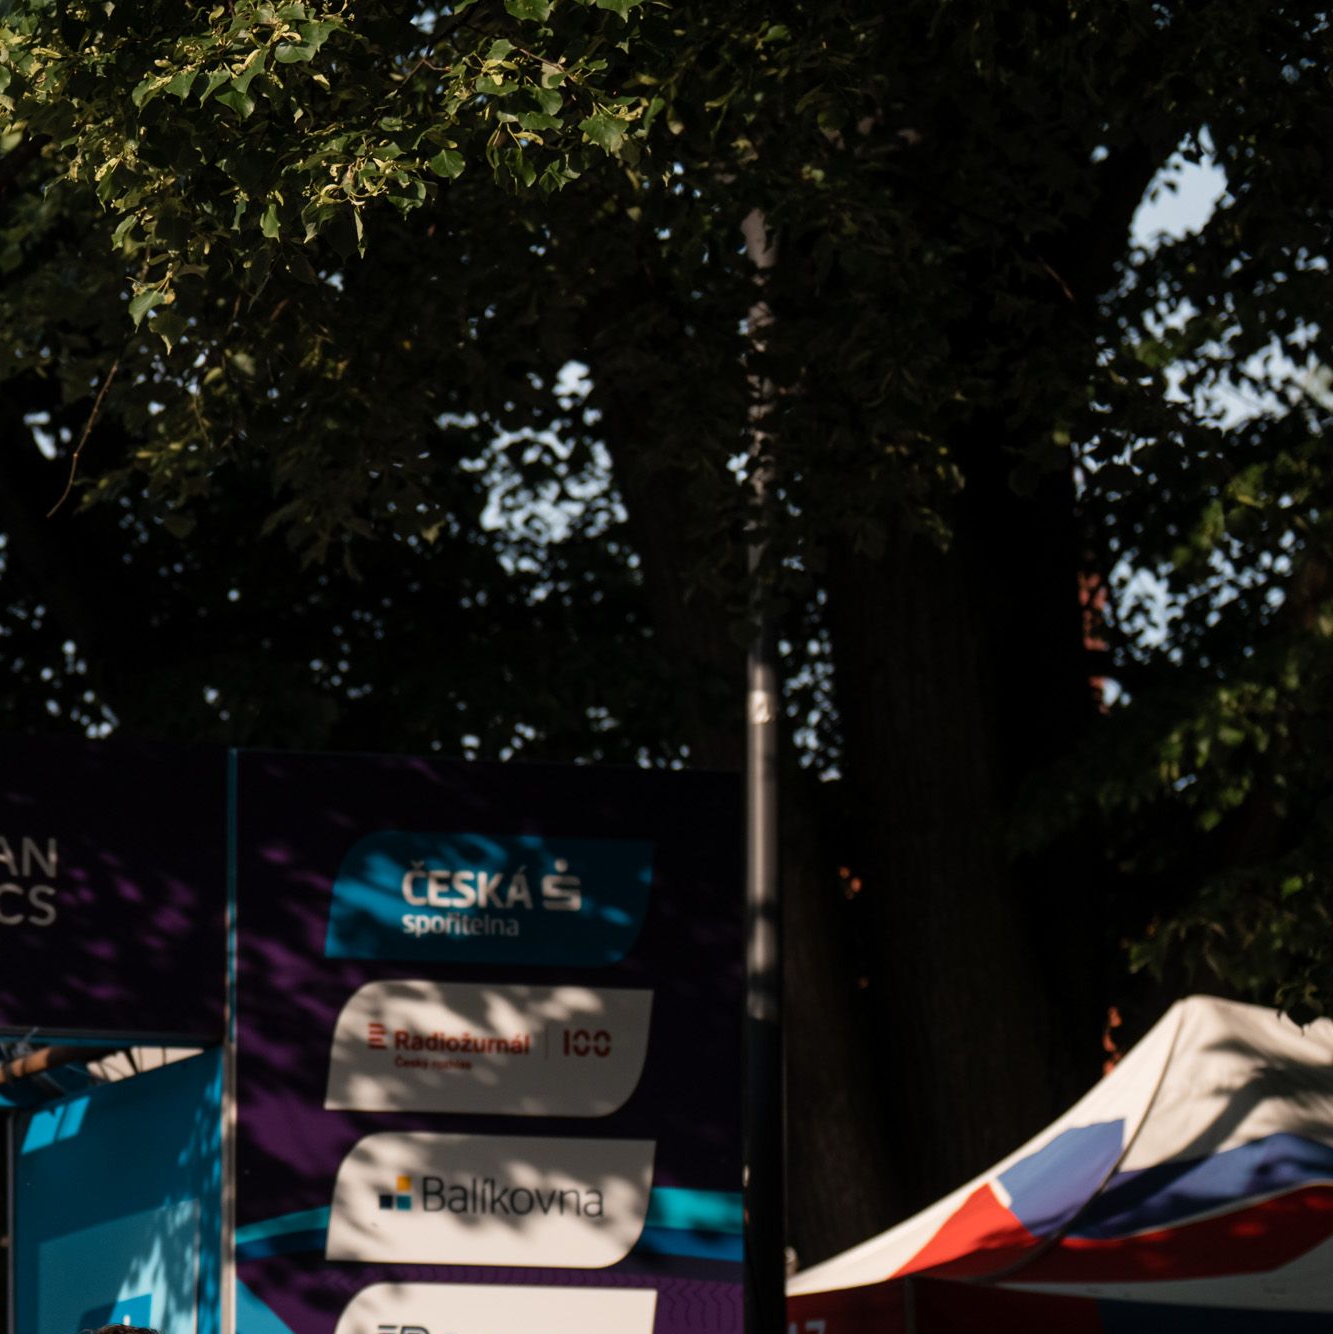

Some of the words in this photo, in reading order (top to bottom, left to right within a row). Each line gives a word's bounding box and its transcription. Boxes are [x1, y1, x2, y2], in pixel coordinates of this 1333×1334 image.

[402, 861, 533, 909] ČESKÁ
[402, 912, 519, 938] spořitelna
[395, 1030, 530, 1056] Radiožurnál
[422, 1176, 605, 1218] Balíkovna
